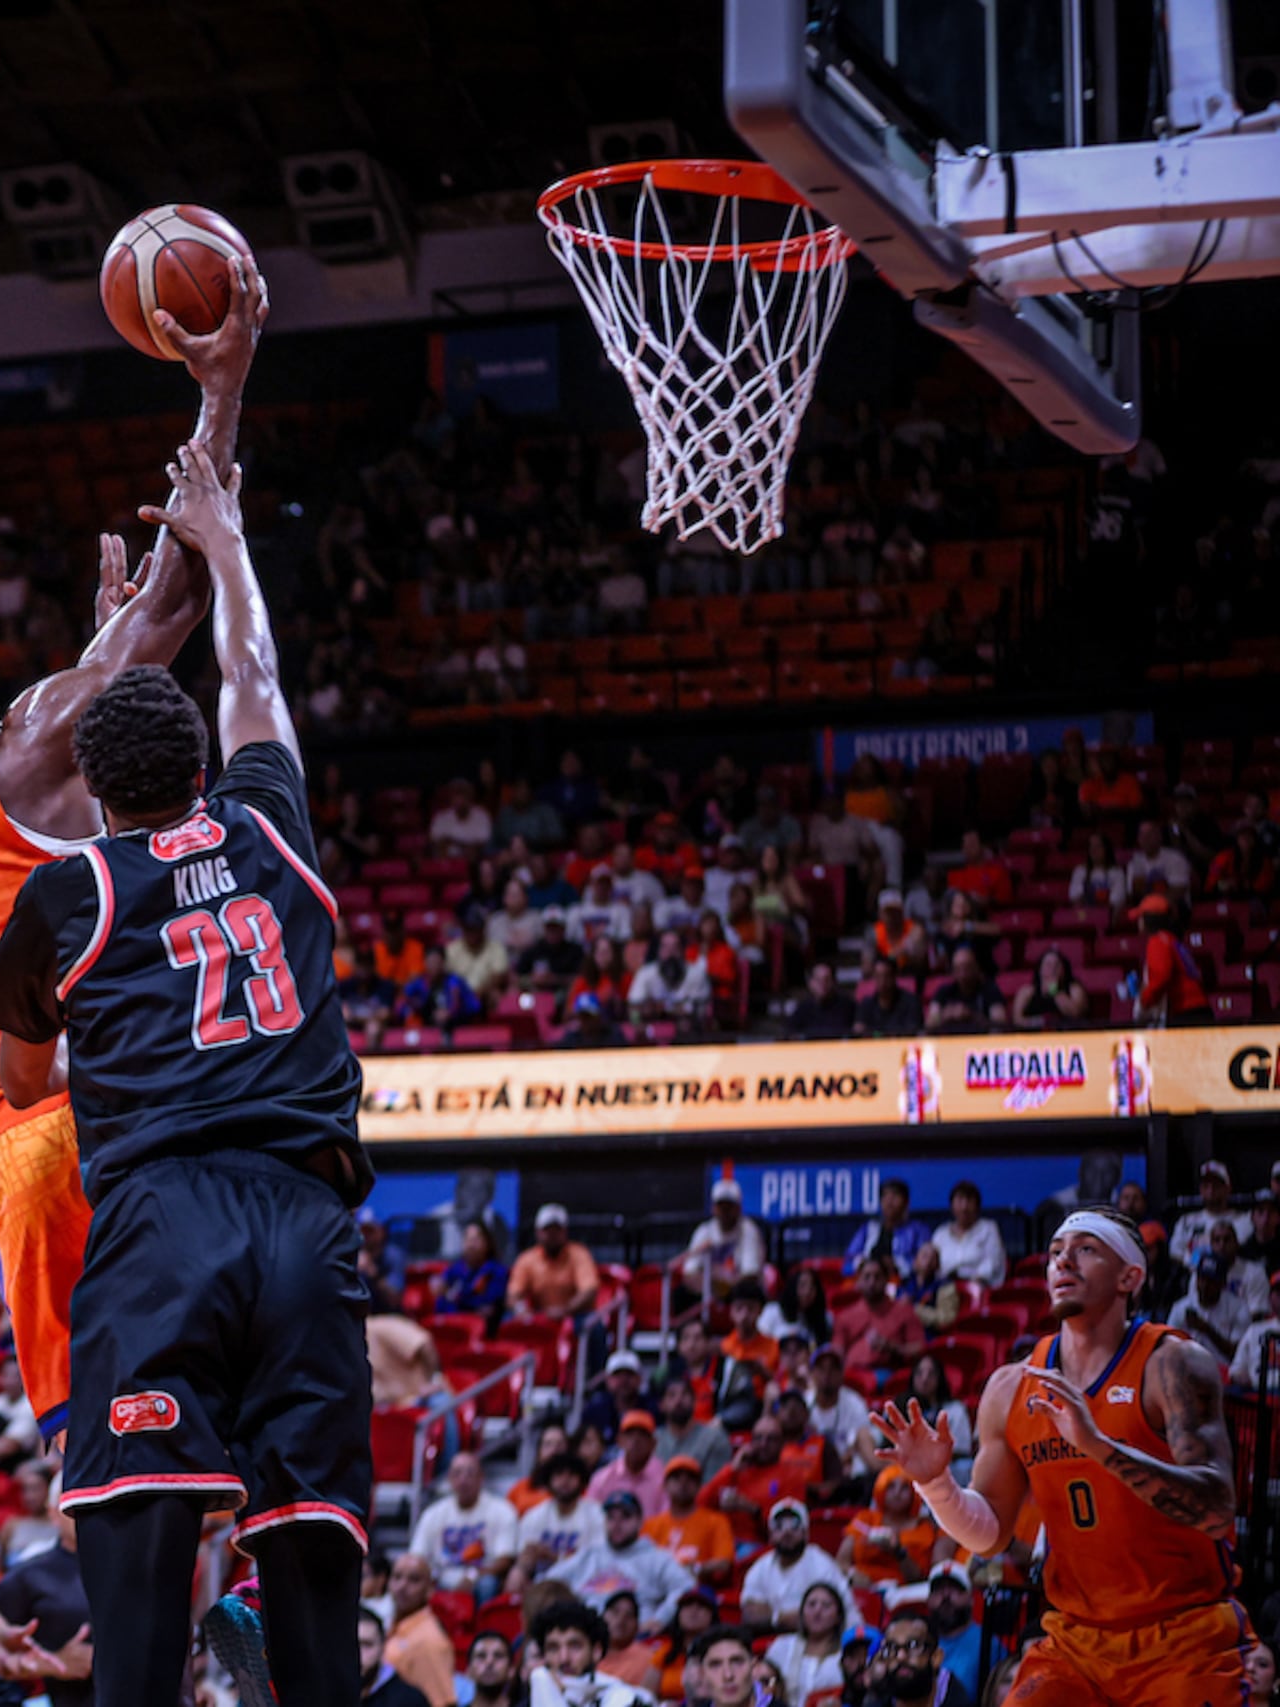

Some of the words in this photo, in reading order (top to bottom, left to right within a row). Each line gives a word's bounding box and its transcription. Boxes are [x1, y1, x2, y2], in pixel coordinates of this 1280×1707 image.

[173, 854, 239, 909] KING
[159, 893, 305, 1050] 23
[966, 1049, 1084, 1080] MEDALLA
[1228, 1045, 1280, 1091] G
[524, 1084, 565, 1109] EN
[575, 1078, 745, 1107] NUESTRAS
[757, 1073, 879, 1101] MANOS
[761, 1169, 852, 1218] PALCO
[1069, 1480, 1098, 1530] 0
